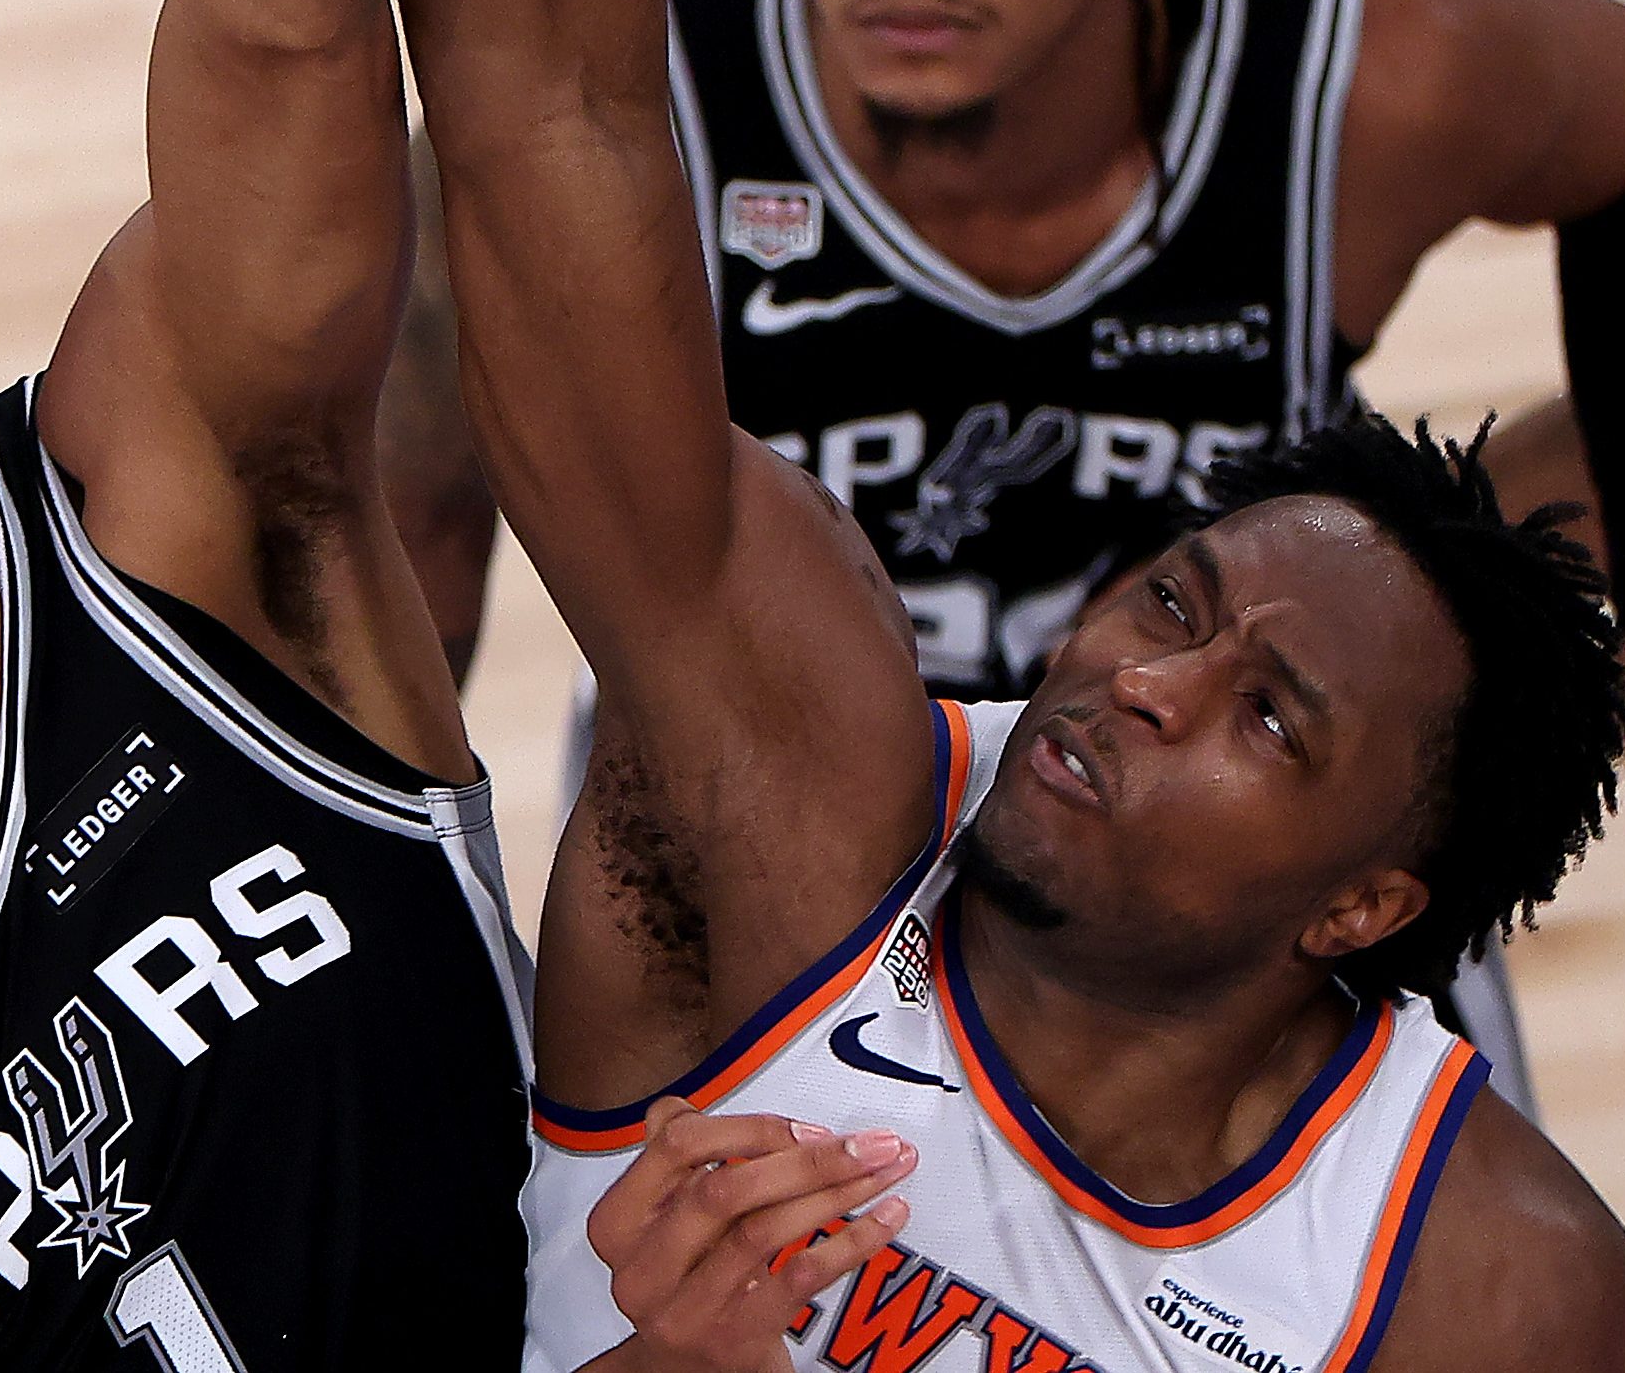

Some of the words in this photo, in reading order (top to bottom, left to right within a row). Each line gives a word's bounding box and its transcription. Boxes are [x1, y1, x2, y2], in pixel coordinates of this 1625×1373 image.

[46, 765, 156, 875] LEDGER
[884, 949, 929, 1006] 250
[1144, 1294, 1208, 1343] abu
[1163, 1278, 1244, 1328] experience
